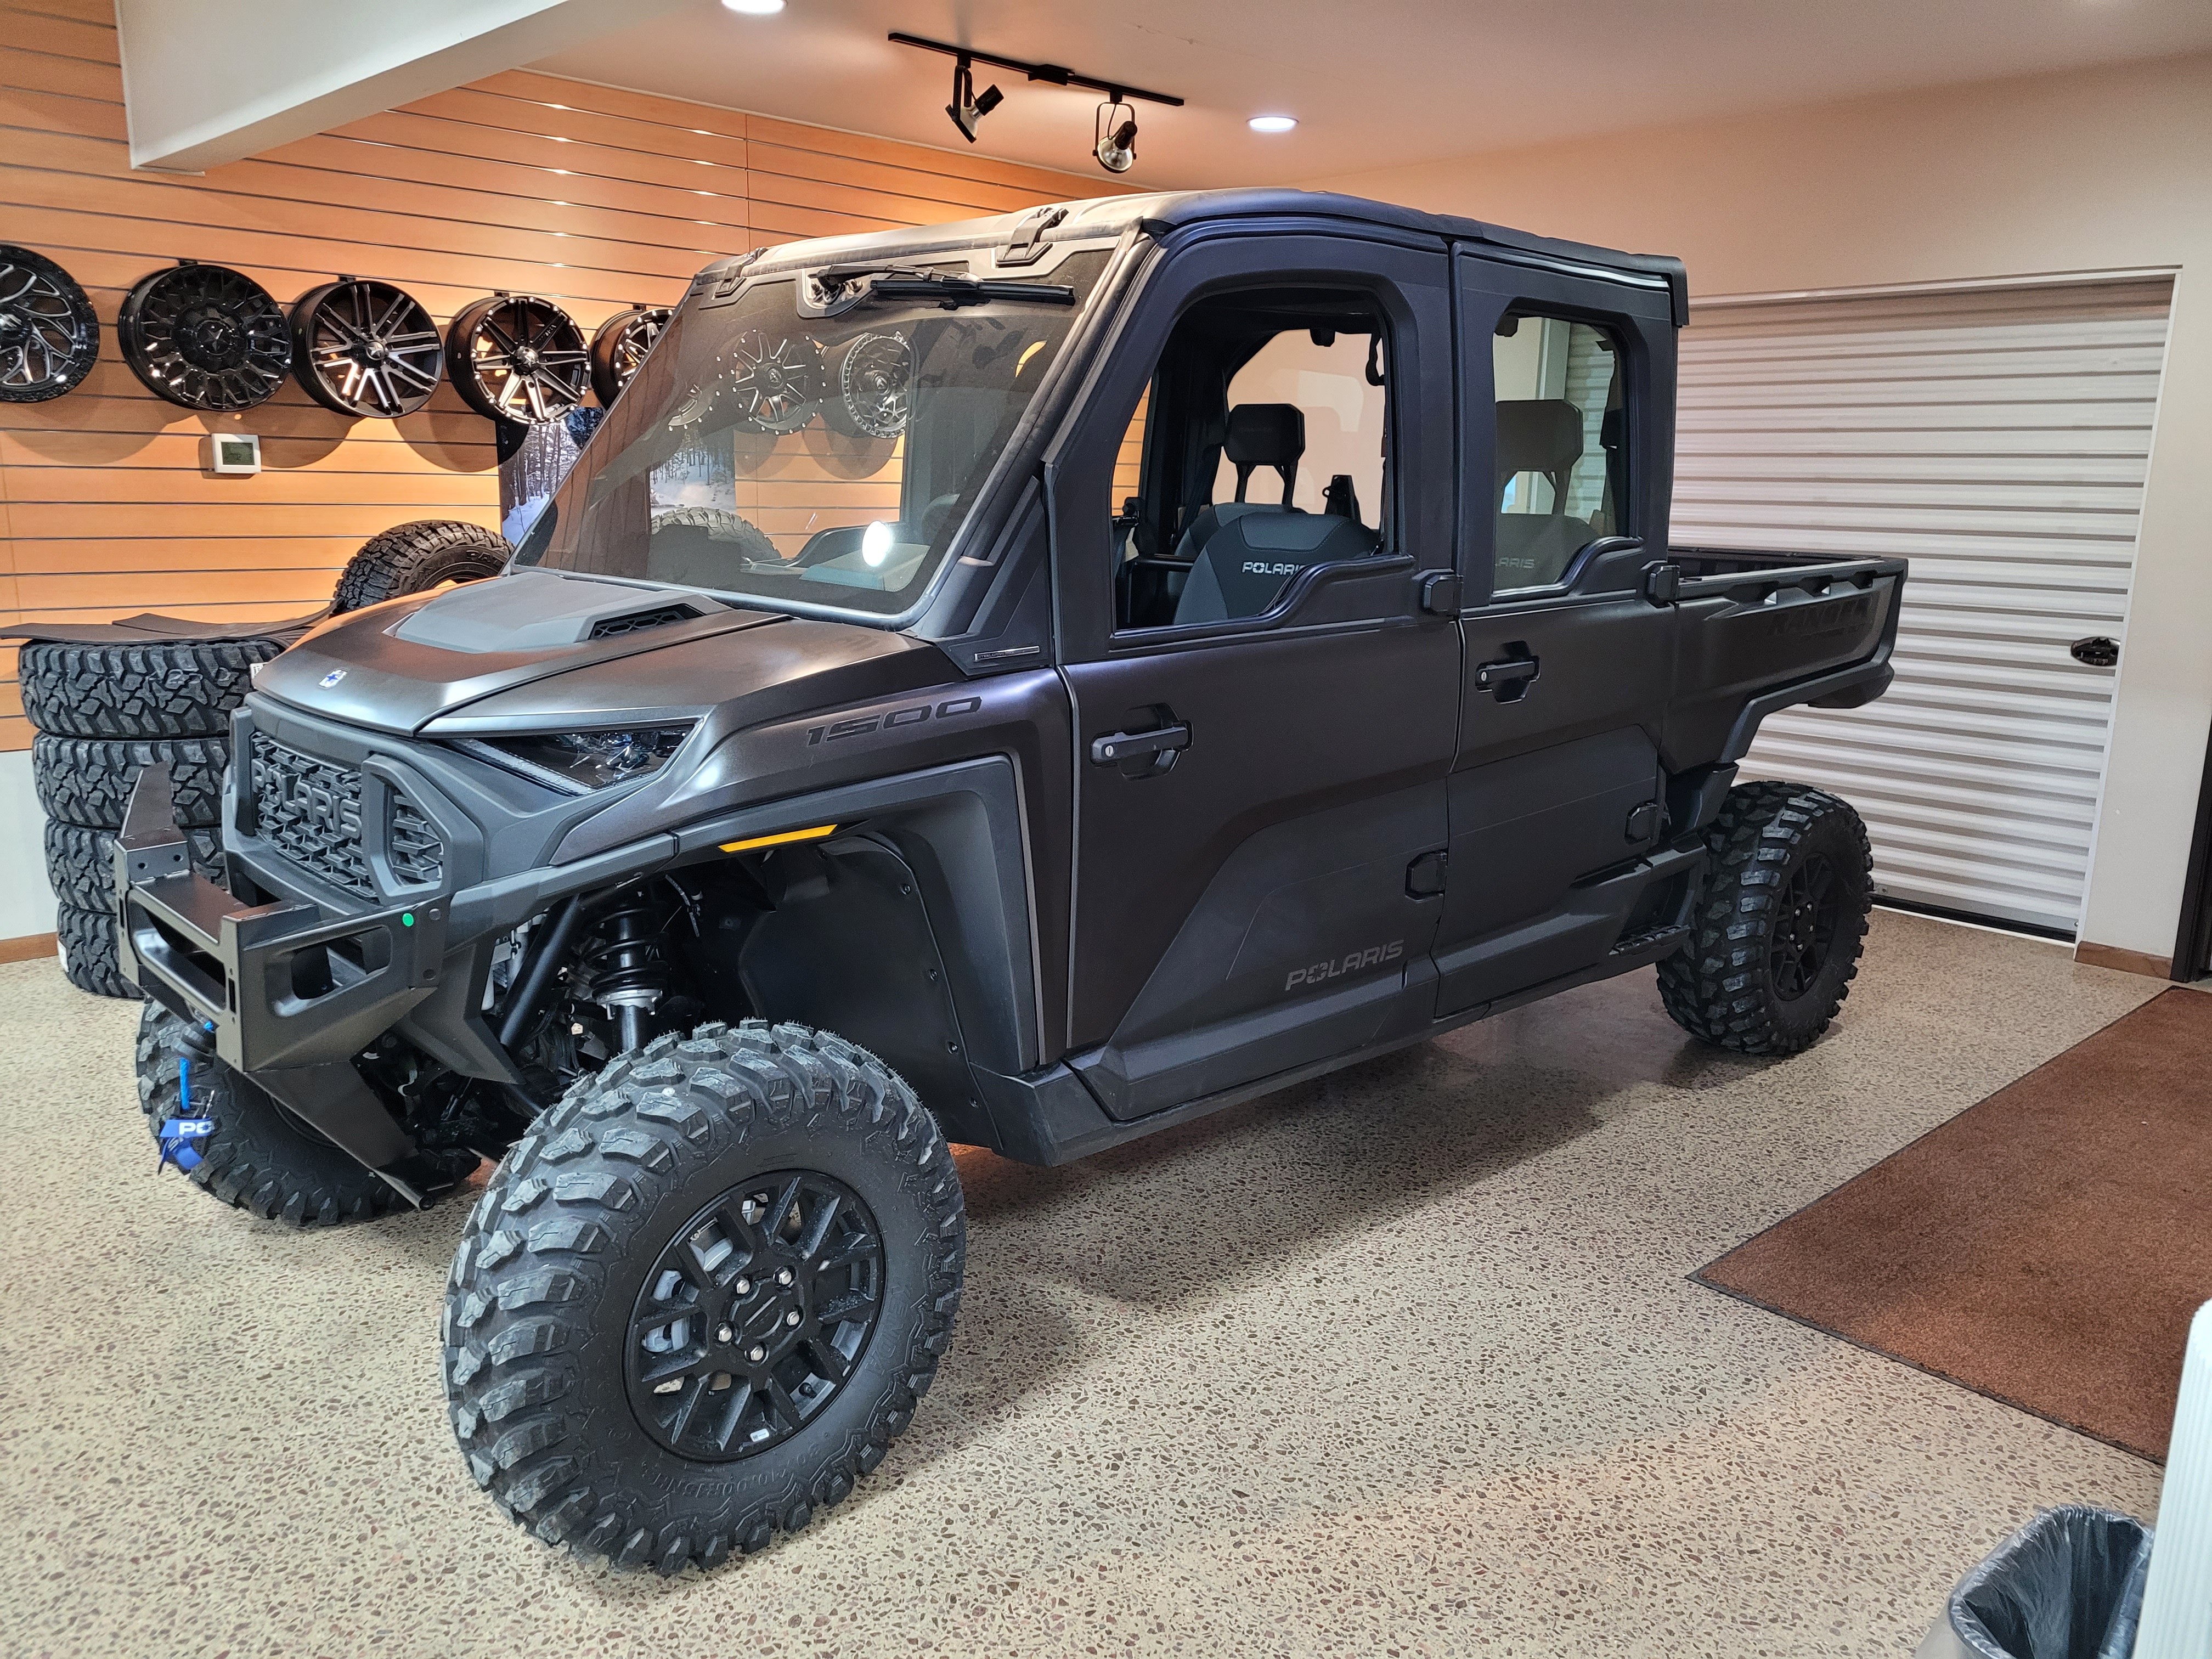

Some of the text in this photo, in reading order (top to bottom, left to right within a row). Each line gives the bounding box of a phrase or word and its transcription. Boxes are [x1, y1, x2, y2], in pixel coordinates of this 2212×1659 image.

[807, 696, 983, 747] 1500
[251, 758, 363, 839] POLARIS
[1285, 939, 1404, 991] POLARIS
